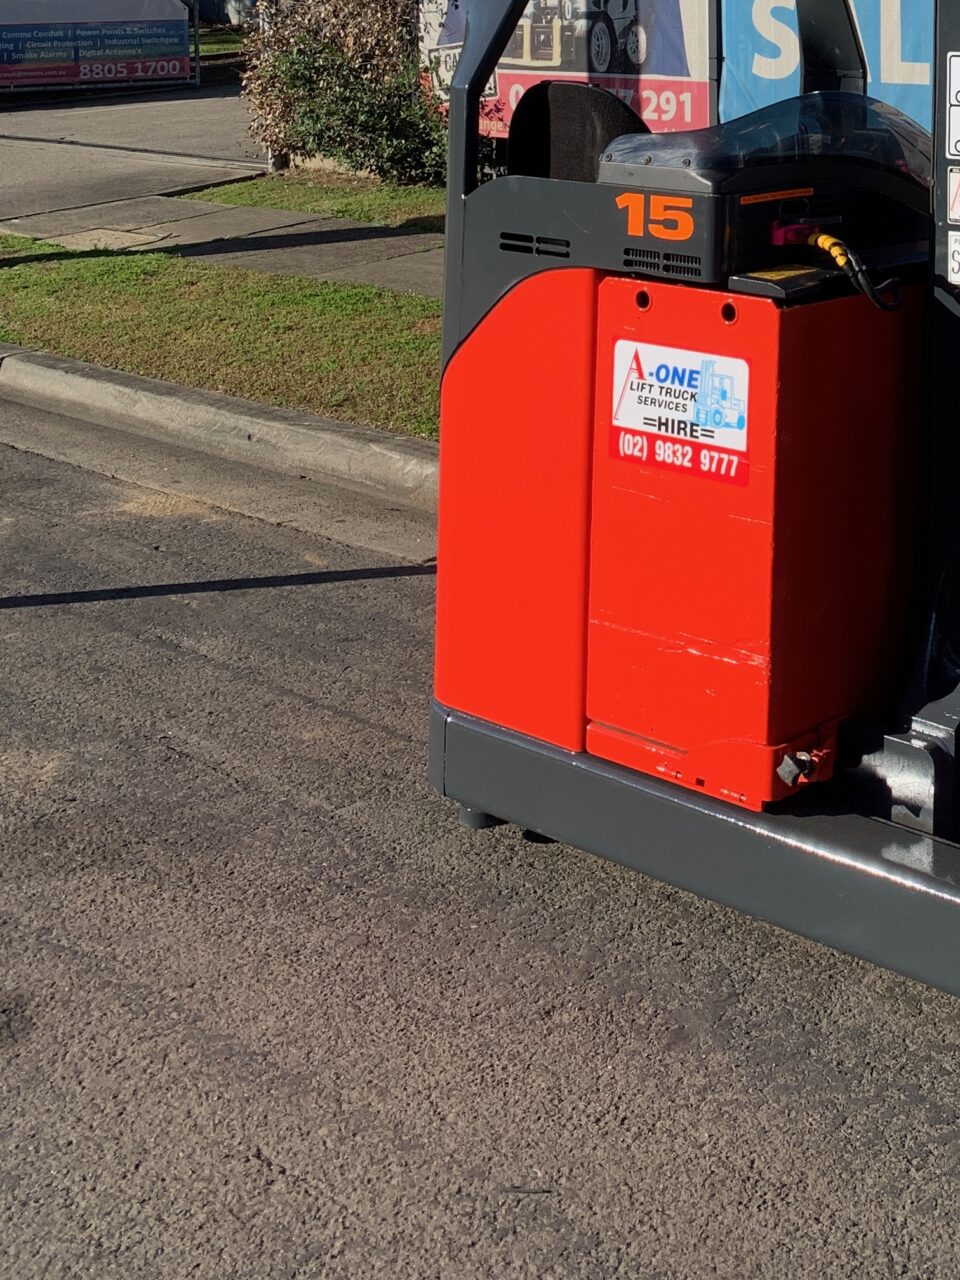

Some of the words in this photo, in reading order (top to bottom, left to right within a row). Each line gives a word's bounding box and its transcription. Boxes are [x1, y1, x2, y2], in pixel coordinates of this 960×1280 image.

[26, 40, 52, 48] Circuit
[53, 39, 93, 48] Protection
[104, 37, 140, 45] Industrial
[141, 35, 180, 45] Switchgear
[33, 30, 64, 38] Conduit
[133, 26, 166, 34] Switches
[11, 51, 37, 59] Smoke
[39, 49, 68, 58] Alarms
[79, 48, 104, 57] Digital
[79, 62, 127, 79] 8805
[134, 60, 180, 76] 1700
[642, 89, 692, 122] 291
[615, 192, 695, 241] 15
[630, 381, 655, 394] LIFT
[658, 386, 698, 403] TRUCK
[637, 395, 688, 413] SERVICES
[619, 431, 648, 461] (02)
[655, 440, 693, 468] 9832
[700, 449, 738, 477] 9777
